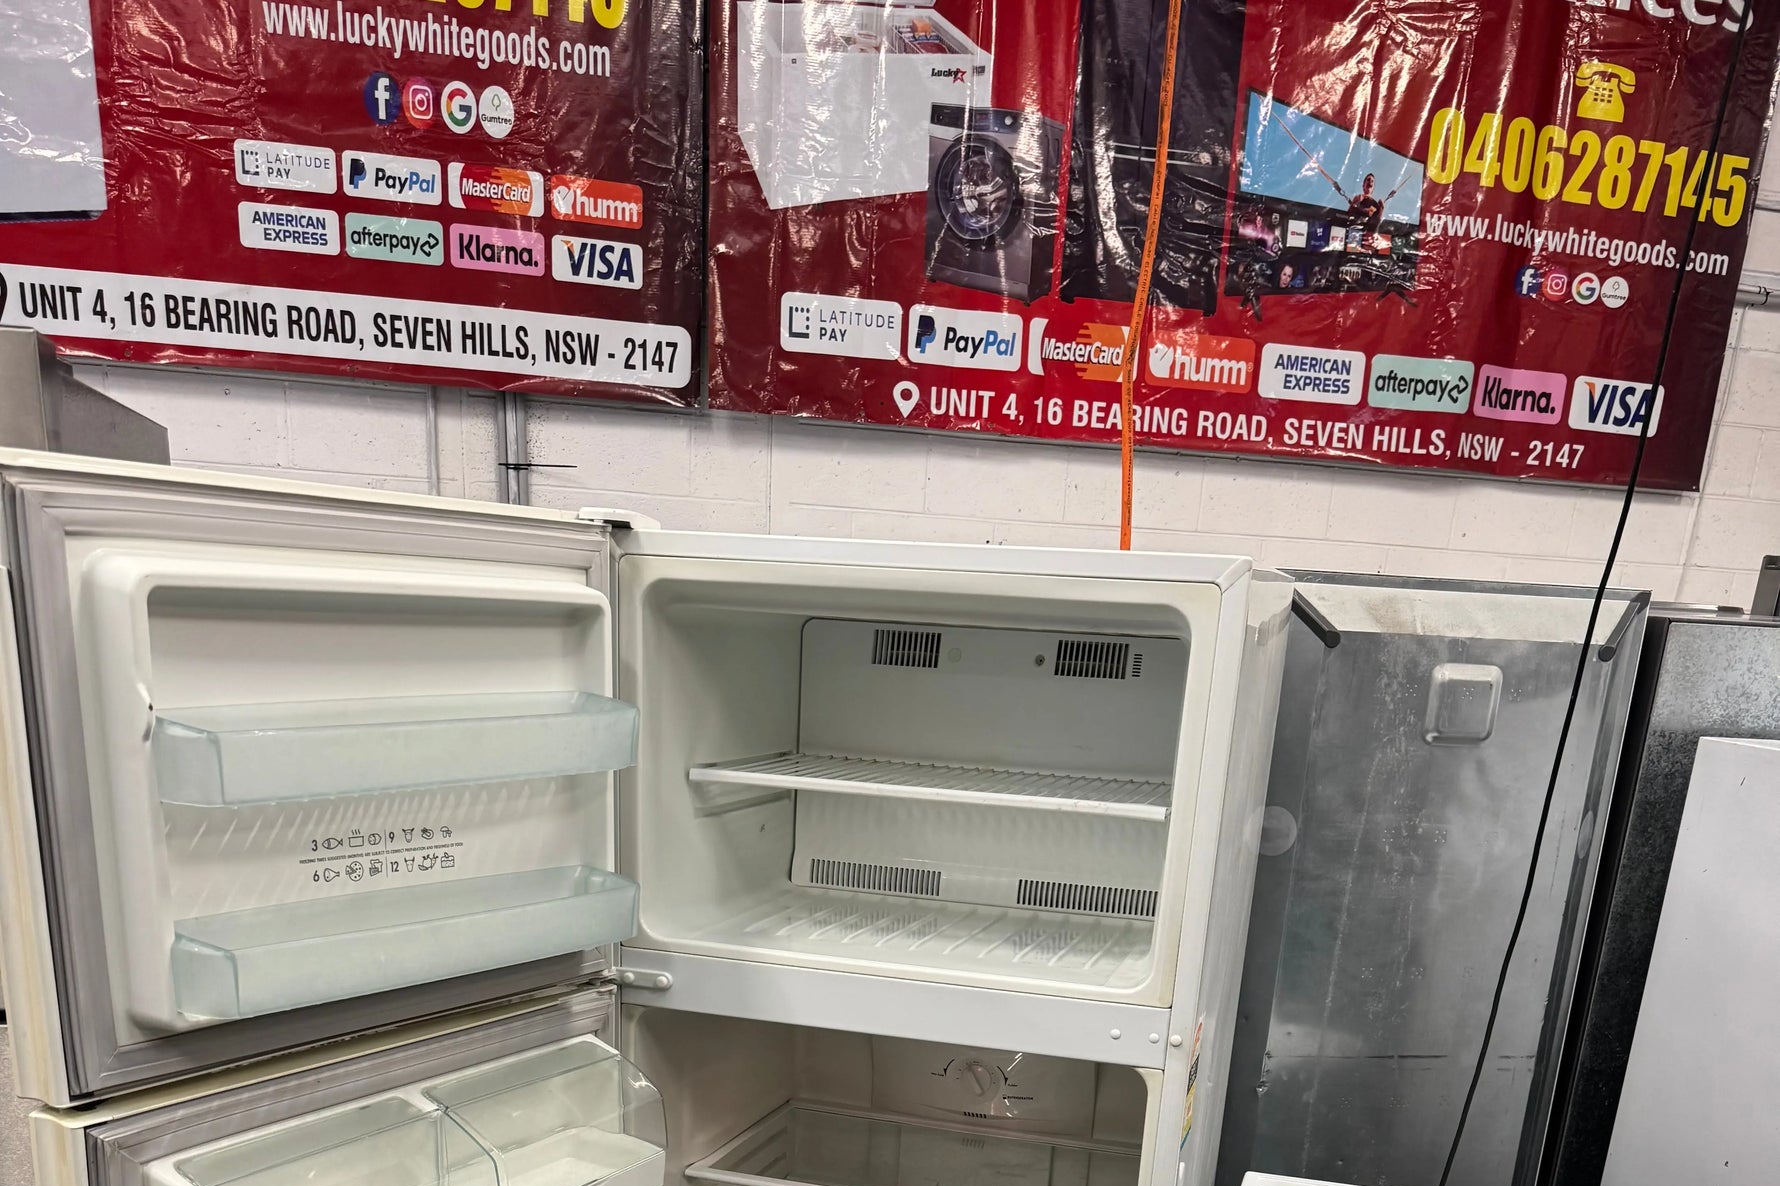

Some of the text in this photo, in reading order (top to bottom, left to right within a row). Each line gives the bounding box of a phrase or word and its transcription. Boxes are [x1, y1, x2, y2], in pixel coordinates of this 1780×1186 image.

[262, 1, 611, 77] www.luckywhitegoods.com
[481, 113, 512, 126] Gumtree
[266, 151, 331, 170] LATITUDE
[267, 167, 291, 180] PAY
[1427, 108, 1750, 227] 0406287145
[374, 167, 435, 195] PayPal
[461, 177, 531, 204] MasterCard
[252, 211, 327, 231] AMERICAN
[263, 228, 329, 247] EXPRESS
[350, 226, 421, 256] afterpay
[459, 232, 540, 268] Klarna.
[1426, 212, 1729, 276] www.luckywhitegoods.com
[561, 239, 635, 283] VISA
[1602, 292, 1628, 301] Gumtree
[19, 281, 83, 322] UNIT
[92, 288, 117, 331] 4,
[124, 290, 156, 328] 16
[164, 293, 278, 338] BEARING
[287, 304, 365, 350] ROAD,
[373, 311, 452, 353] SEVEN
[461, 320, 537, 367] HILLS,
[545, 329, 600, 367] NSW
[624, 337, 678, 373] 2147
[818, 307, 896, 330] LATITUDE
[819, 327, 848, 342] PAY
[944, 326, 1016, 359] PayPal
[1042, 337, 1124, 366] MasterCard
[1274, 353, 1353, 376] AMERICAN
[1283, 374, 1351, 395] EXPRESS
[1374, 371, 1449, 402] afterpay
[1481, 375, 1556, 415] Klarna.
[1584, 381, 1654, 428] VISA
[930, 386, 995, 418] UNIT
[1001, 393, 1024, 426] 4,
[1034, 397, 1063, 426] 16
[1072, 399, 1188, 436] BEARING
[1197, 410, 1275, 448] ROAD,
[1283, 417, 1365, 450] SEVEN
[1372, 424, 1451, 460] HILLS,
[1457, 433, 1504, 463] NSW
[1526, 440, 1585, 469] 2147
[311, 839, 318, 851] 3
[388, 831, 395, 843] 9
[312, 870, 320, 882] 6
[390, 861, 399, 873] 12
